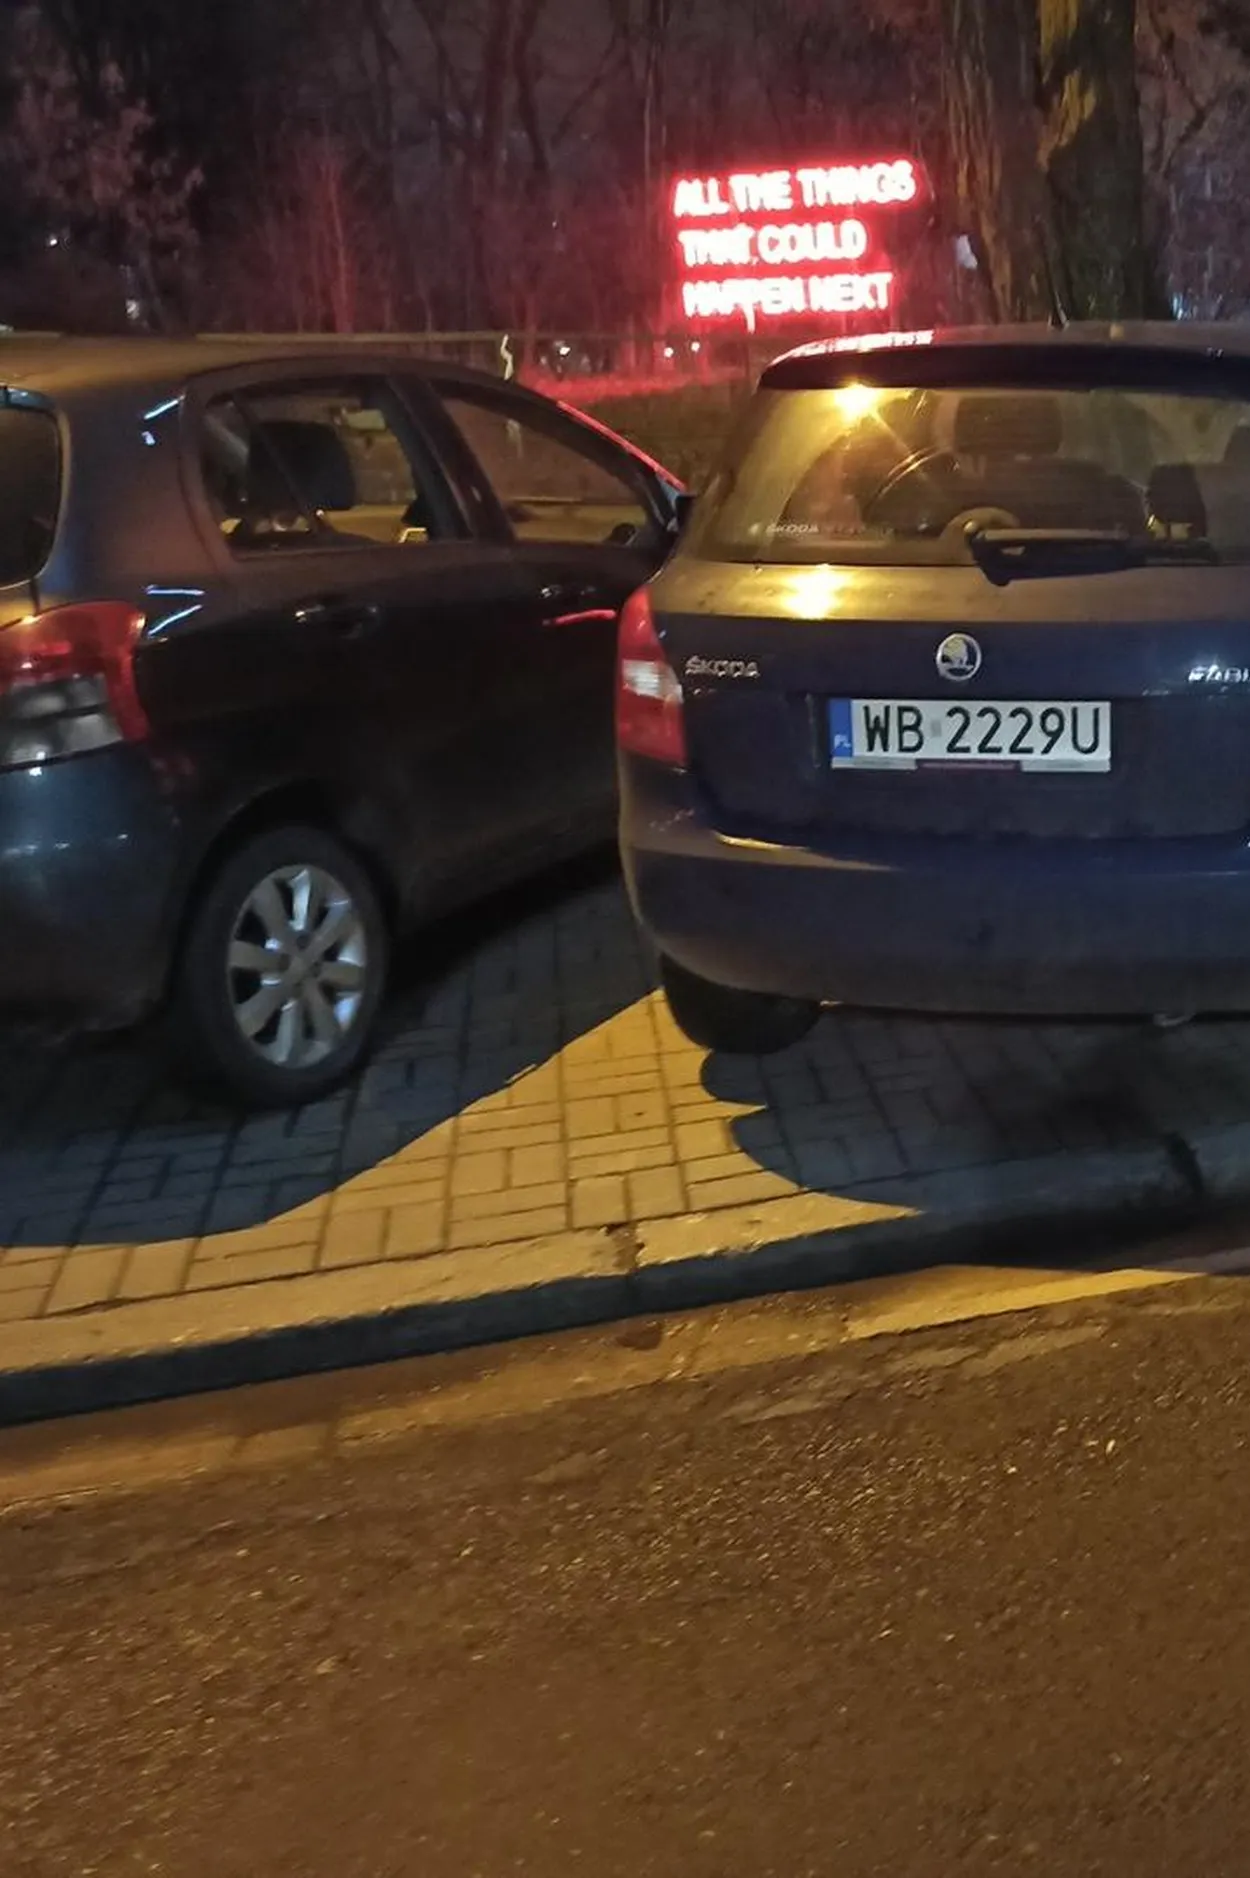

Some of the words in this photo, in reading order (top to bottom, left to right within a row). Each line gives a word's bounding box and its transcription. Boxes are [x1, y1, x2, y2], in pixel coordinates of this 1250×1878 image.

[673, 177, 729, 218] ALL
[729, 170, 793, 213] THE
[797, 160, 916, 207] THINGS
[678, 223, 754, 267] THAT
[757, 219, 867, 264] COULD
[682, 276, 804, 333] HAPPEN
[808, 272, 893, 312] NEXT
[864, 705, 923, 753] WB
[946, 707, 1100, 755] 2229U
